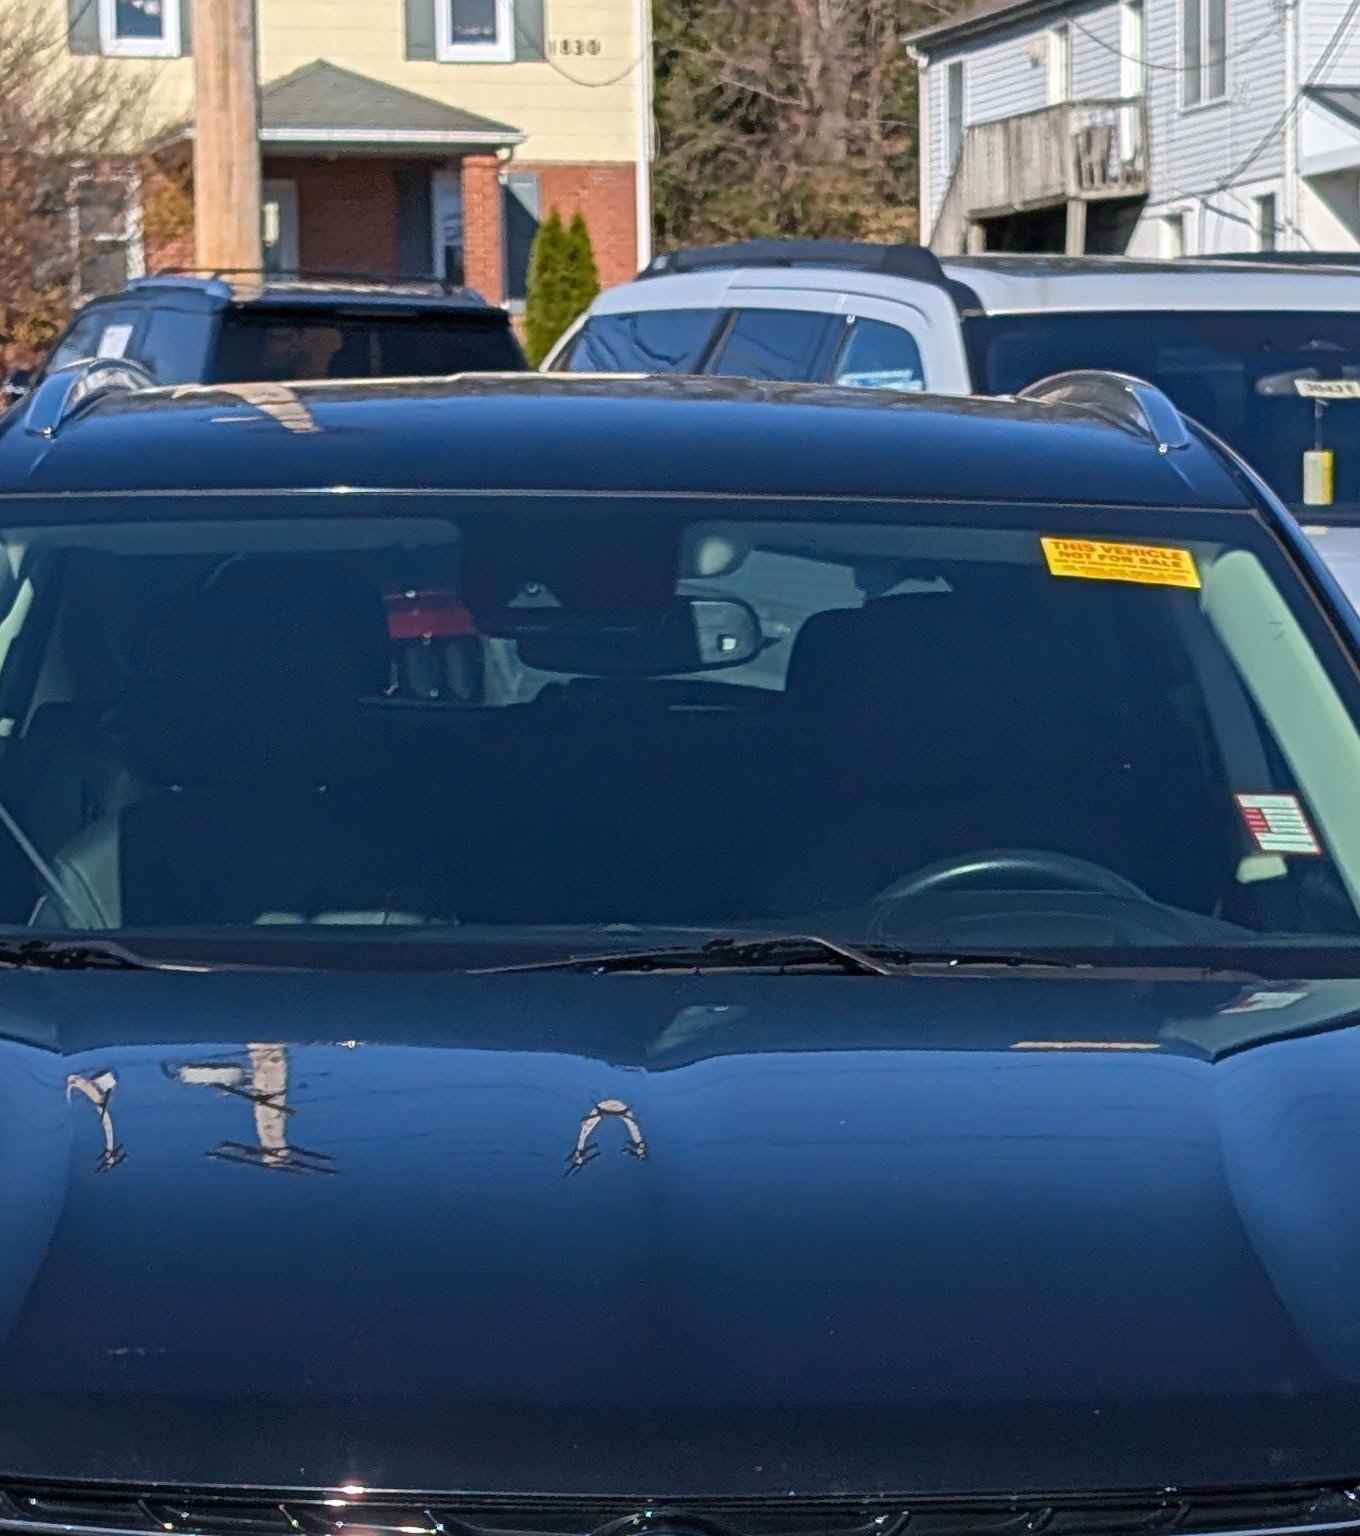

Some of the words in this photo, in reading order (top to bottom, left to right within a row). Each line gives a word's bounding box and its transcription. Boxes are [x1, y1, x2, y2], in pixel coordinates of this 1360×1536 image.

[1051, 541, 1096, 552] THIS
[1100, 545, 1183, 561] VEHICLE
[1058, 551, 1092, 560] NOT
[1097, 554, 1134, 563] FOR
[1139, 557, 1183, 568] SALE
